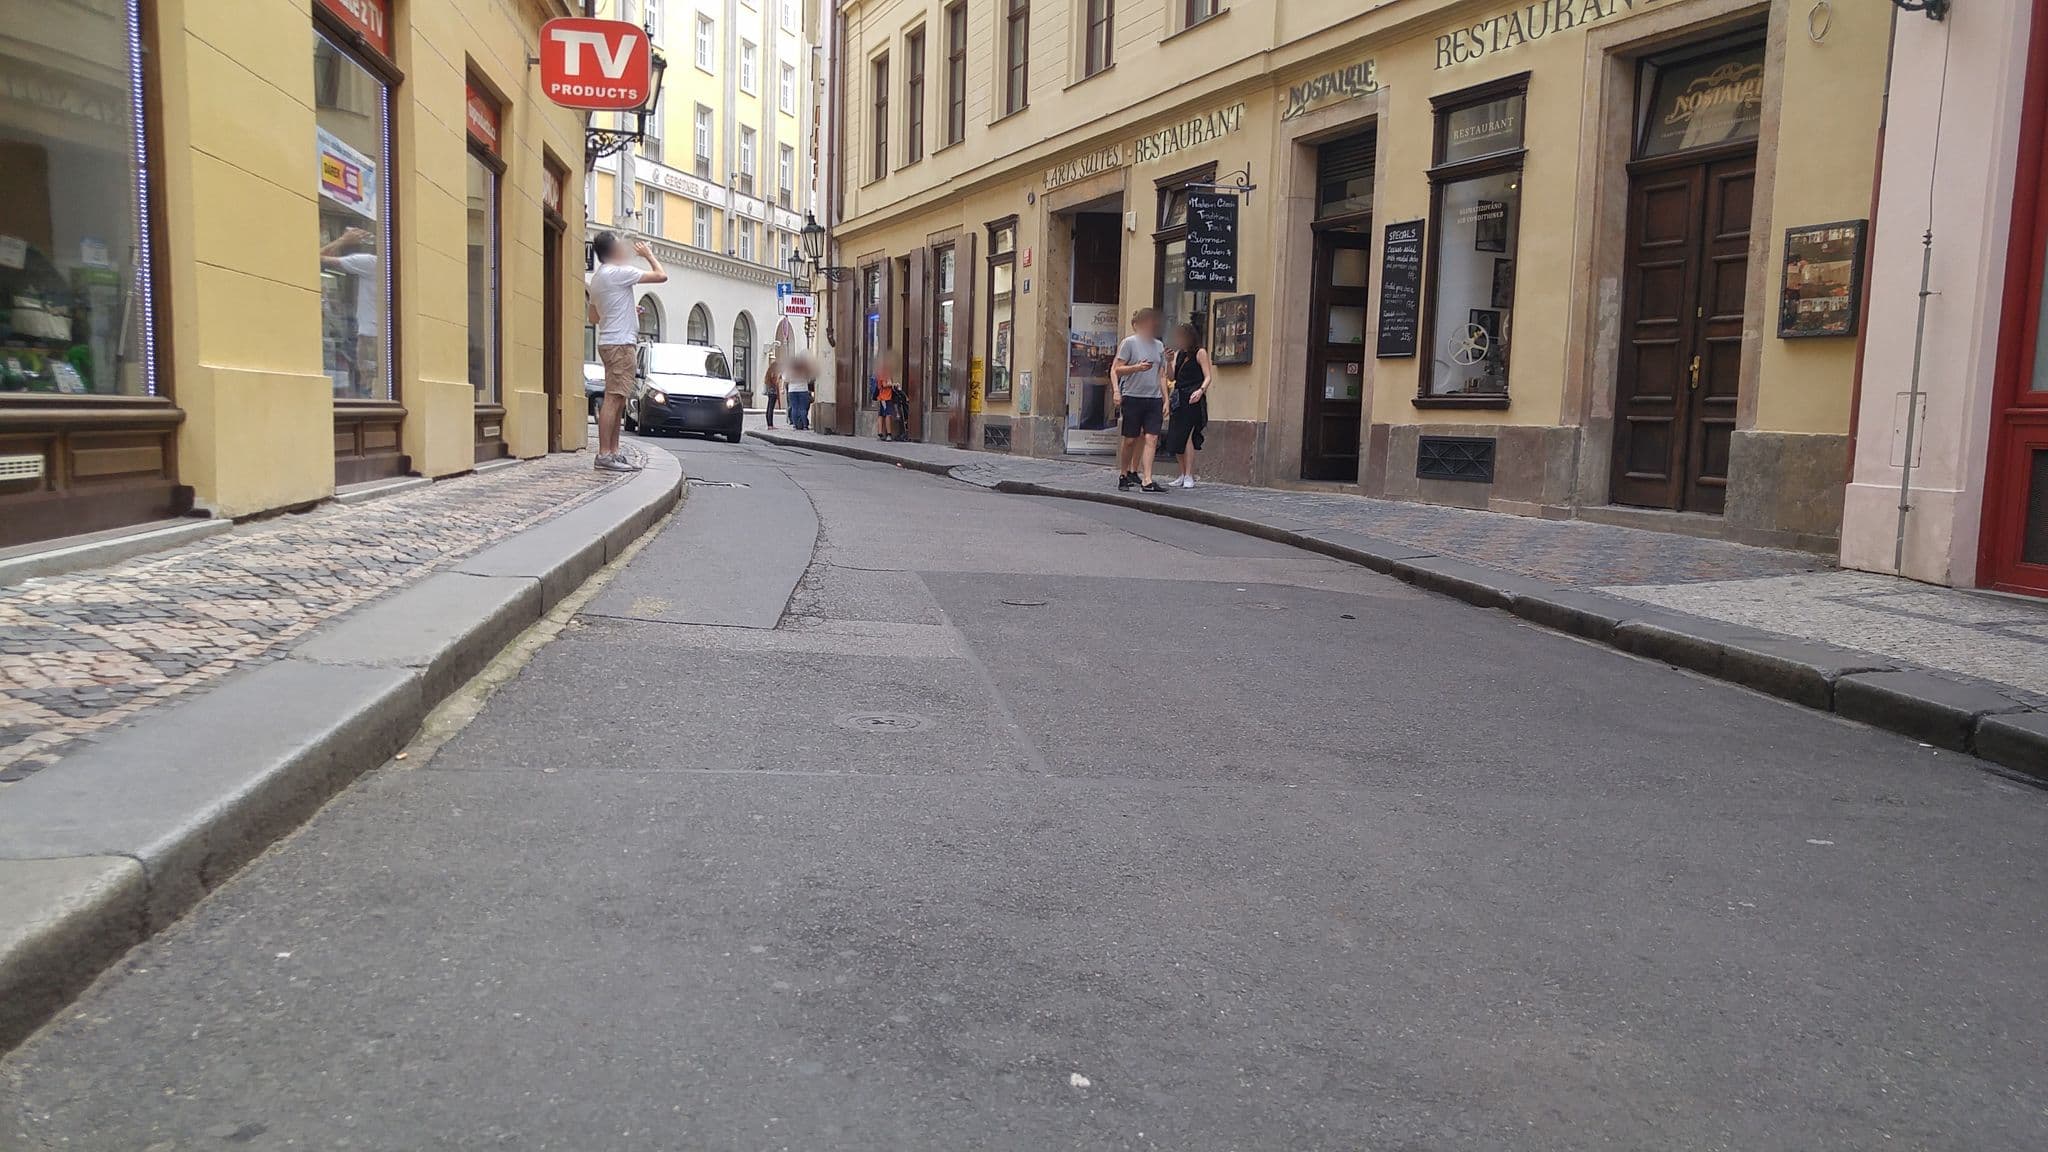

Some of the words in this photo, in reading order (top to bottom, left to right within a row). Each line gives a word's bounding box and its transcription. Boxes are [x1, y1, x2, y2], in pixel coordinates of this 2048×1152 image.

[368, 0, 384, 39] TV
[1434, 0, 1655, 70] RESTAURA
[551, 28, 638, 79] TV
[551, 83, 638, 100] PRODUCTS
[1664, 77, 1763, 125] NOSTALGI
[1134, 103, 1246, 164] RESTAURANT
[1453, 117, 1514, 140] RESTAURANT
[1050, 159, 1078, 187] ARTS
[1079, 144, 1119, 178] SUITES
[786, 305, 811, 314] MARKET
[791, 296, 806, 306] MINI
